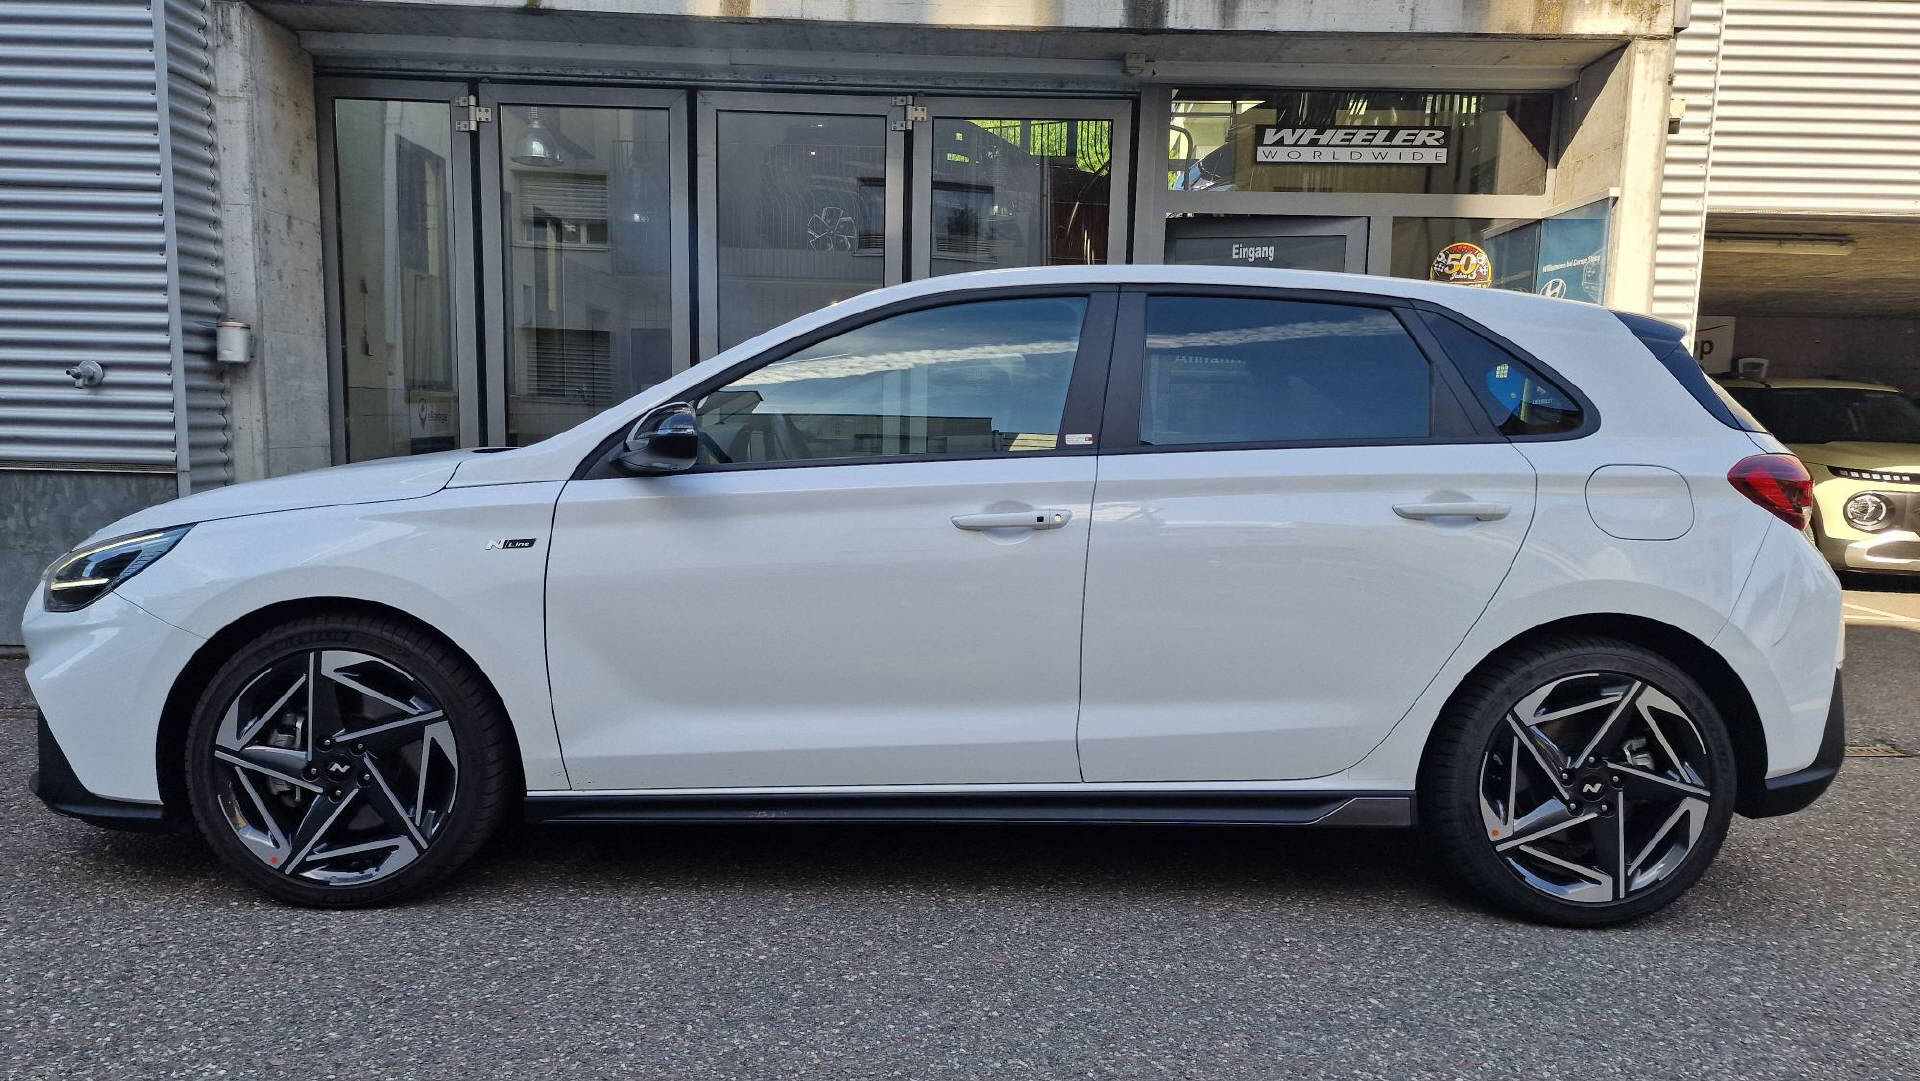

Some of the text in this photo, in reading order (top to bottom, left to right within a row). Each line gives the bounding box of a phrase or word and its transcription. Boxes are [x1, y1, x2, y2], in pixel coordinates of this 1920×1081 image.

[1262, 128, 1441, 146] WHEELER
[1262, 150, 1443, 161] WORLDWIDE
[1232, 243, 1274, 262] Eingang
[1443, 253, 1478, 275] 50
